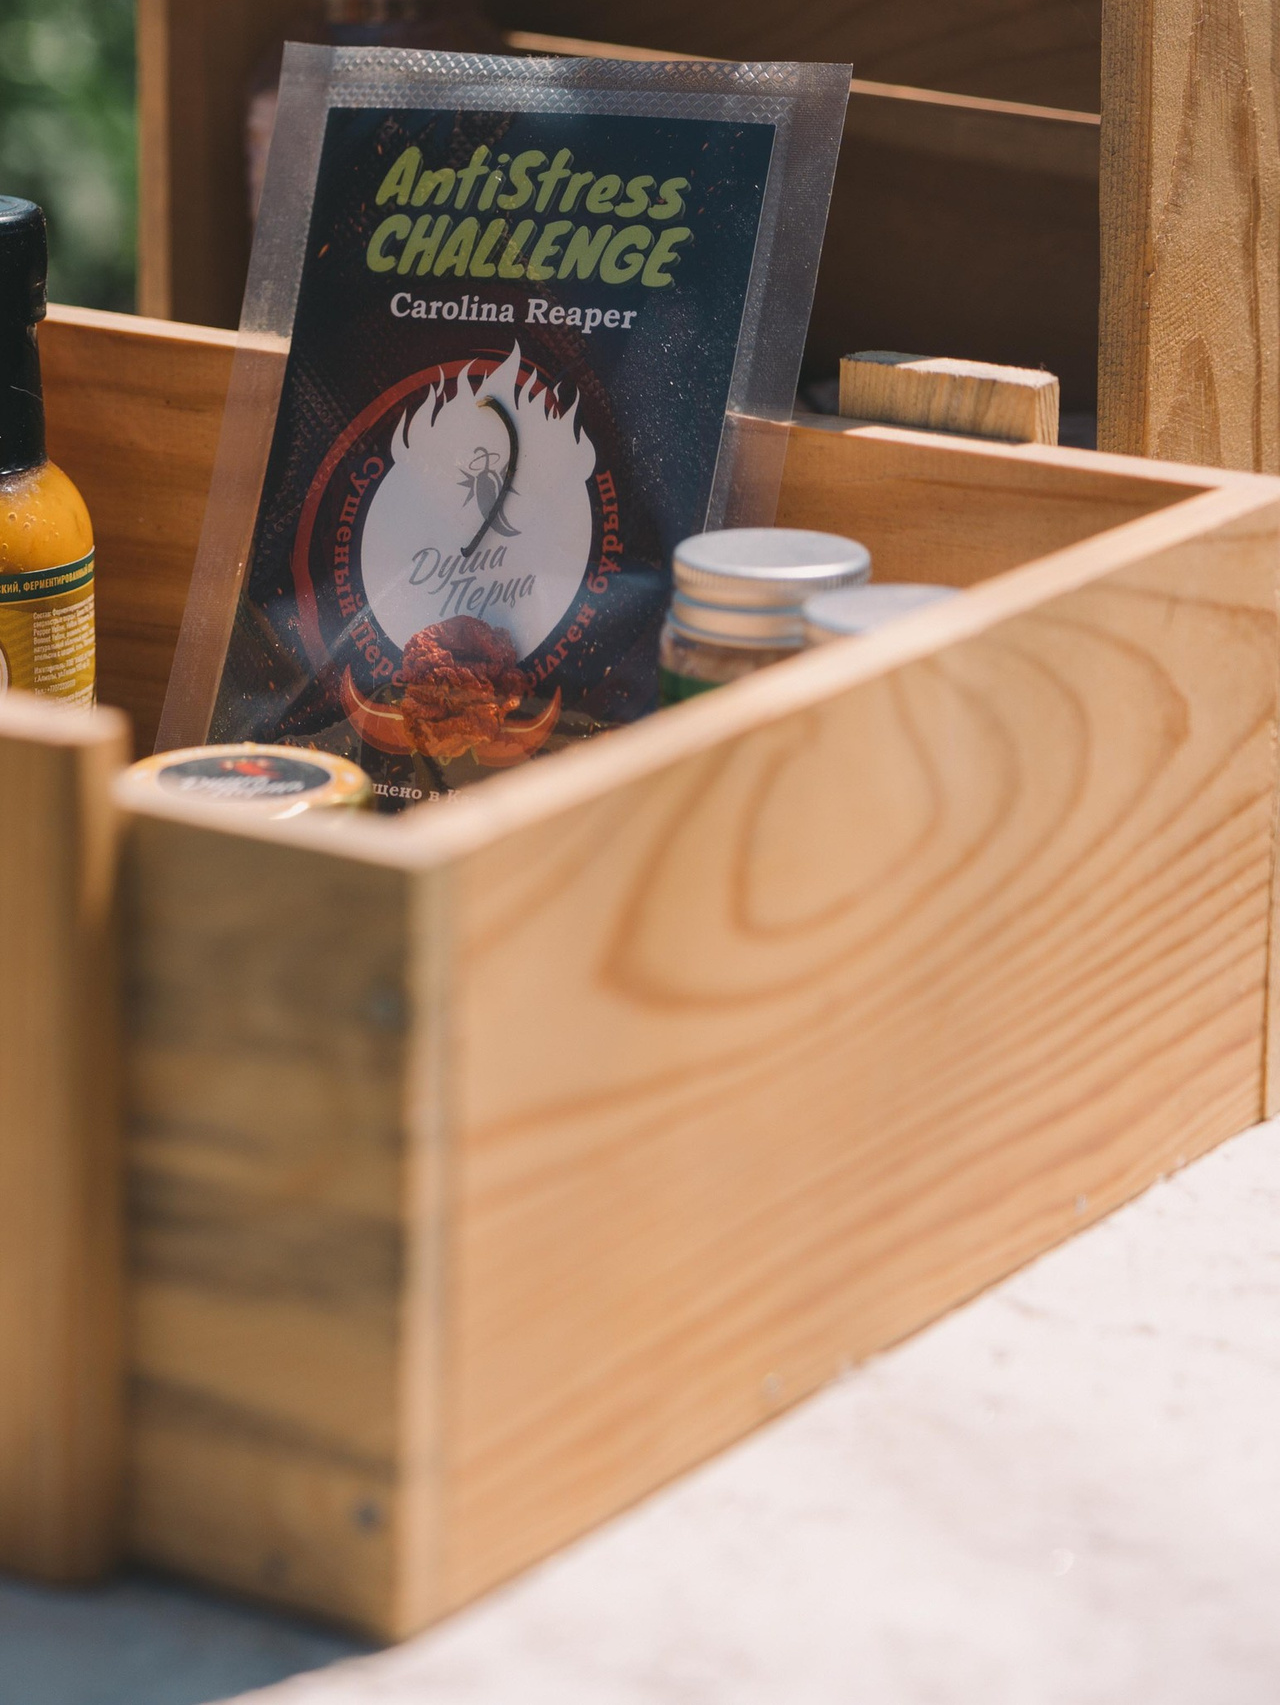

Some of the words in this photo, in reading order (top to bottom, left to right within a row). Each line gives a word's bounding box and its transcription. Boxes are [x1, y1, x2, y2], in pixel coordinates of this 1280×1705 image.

[375, 145, 692, 220] AntiStress
[366, 214, 694, 288] CHALLENGE
[390, 292, 515, 324] Carolina
[524, 298, 638, 334] Reaper
[333, 456, 385, 618] Сушеный
[438, 574, 537, 619] Перца
